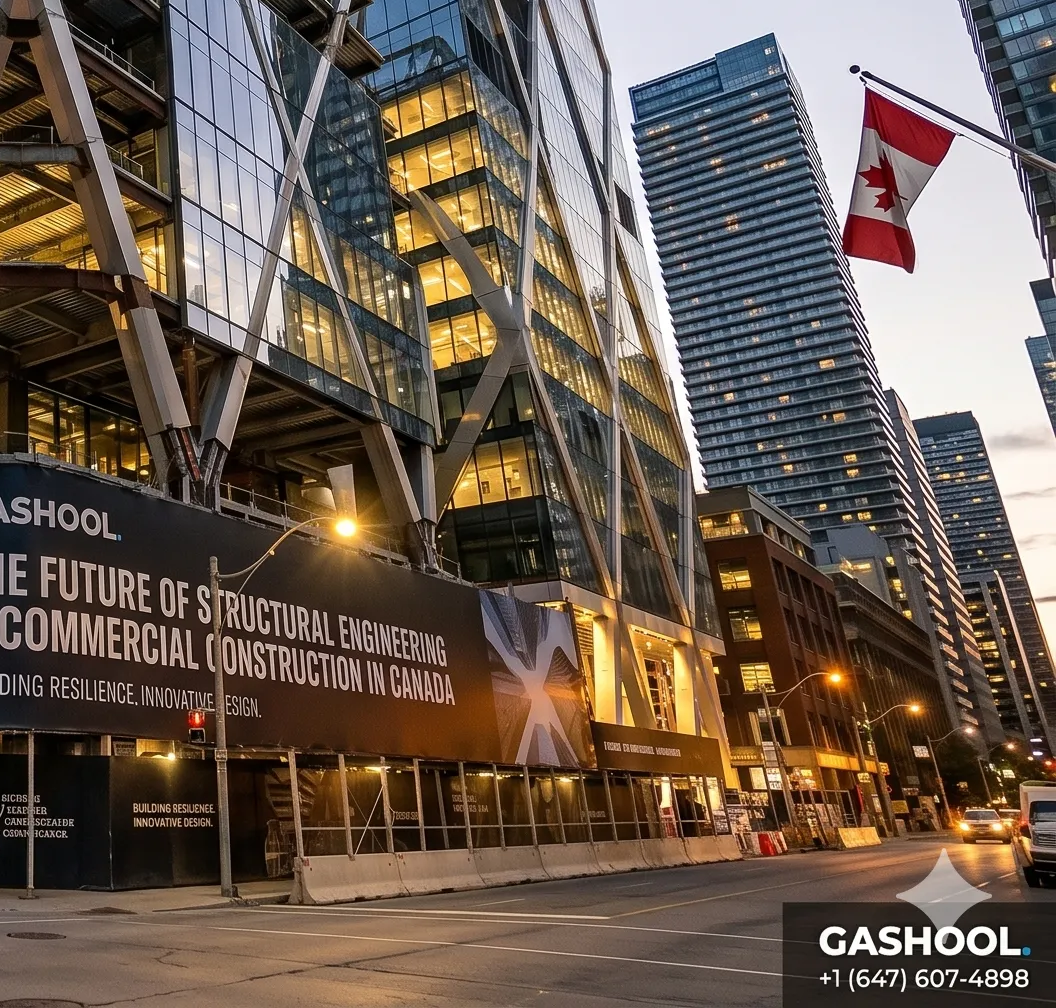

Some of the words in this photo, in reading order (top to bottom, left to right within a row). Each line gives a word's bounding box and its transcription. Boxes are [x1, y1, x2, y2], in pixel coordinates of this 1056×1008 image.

[40, 555, 152, 613] FUTURE
[159, 577, 189, 619] OF
[338, 614, 448, 667] ENGINEERING
[50, 676, 138, 706] RESILIENCE.
[141, 685, 214, 710] INNOVATIVE
[225, 695, 262, 718] ESIGN.
[366, 660, 386, 696] IN
[389, 665, 456, 706] CANADA
[133, 803, 171, 814] BUILDING
[133, 817, 182, 827] INNOVATIVE
